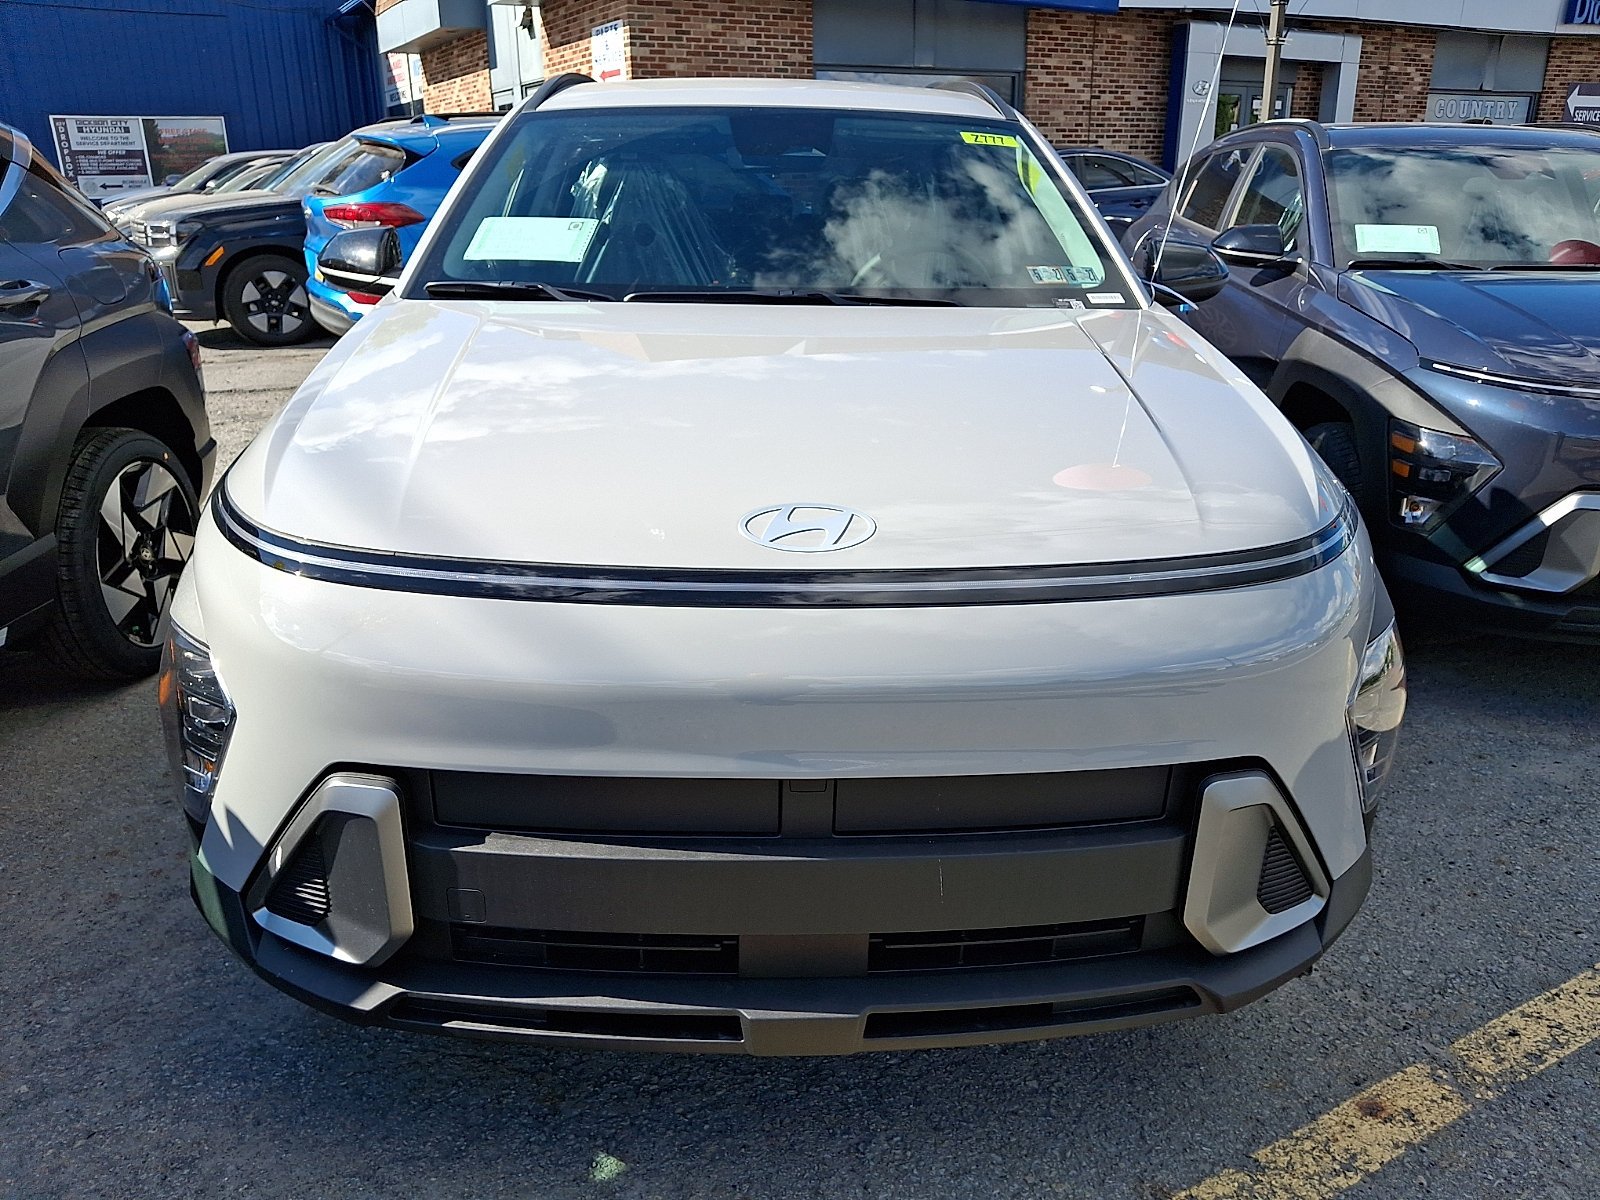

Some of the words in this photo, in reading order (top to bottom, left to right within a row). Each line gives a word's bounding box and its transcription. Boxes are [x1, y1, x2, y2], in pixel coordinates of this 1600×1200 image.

[1434, 99, 1518, 119] COUNTRY
[1574, 110, 1600, 121] SERVICE
[970, 133, 1005, 145] Z777
